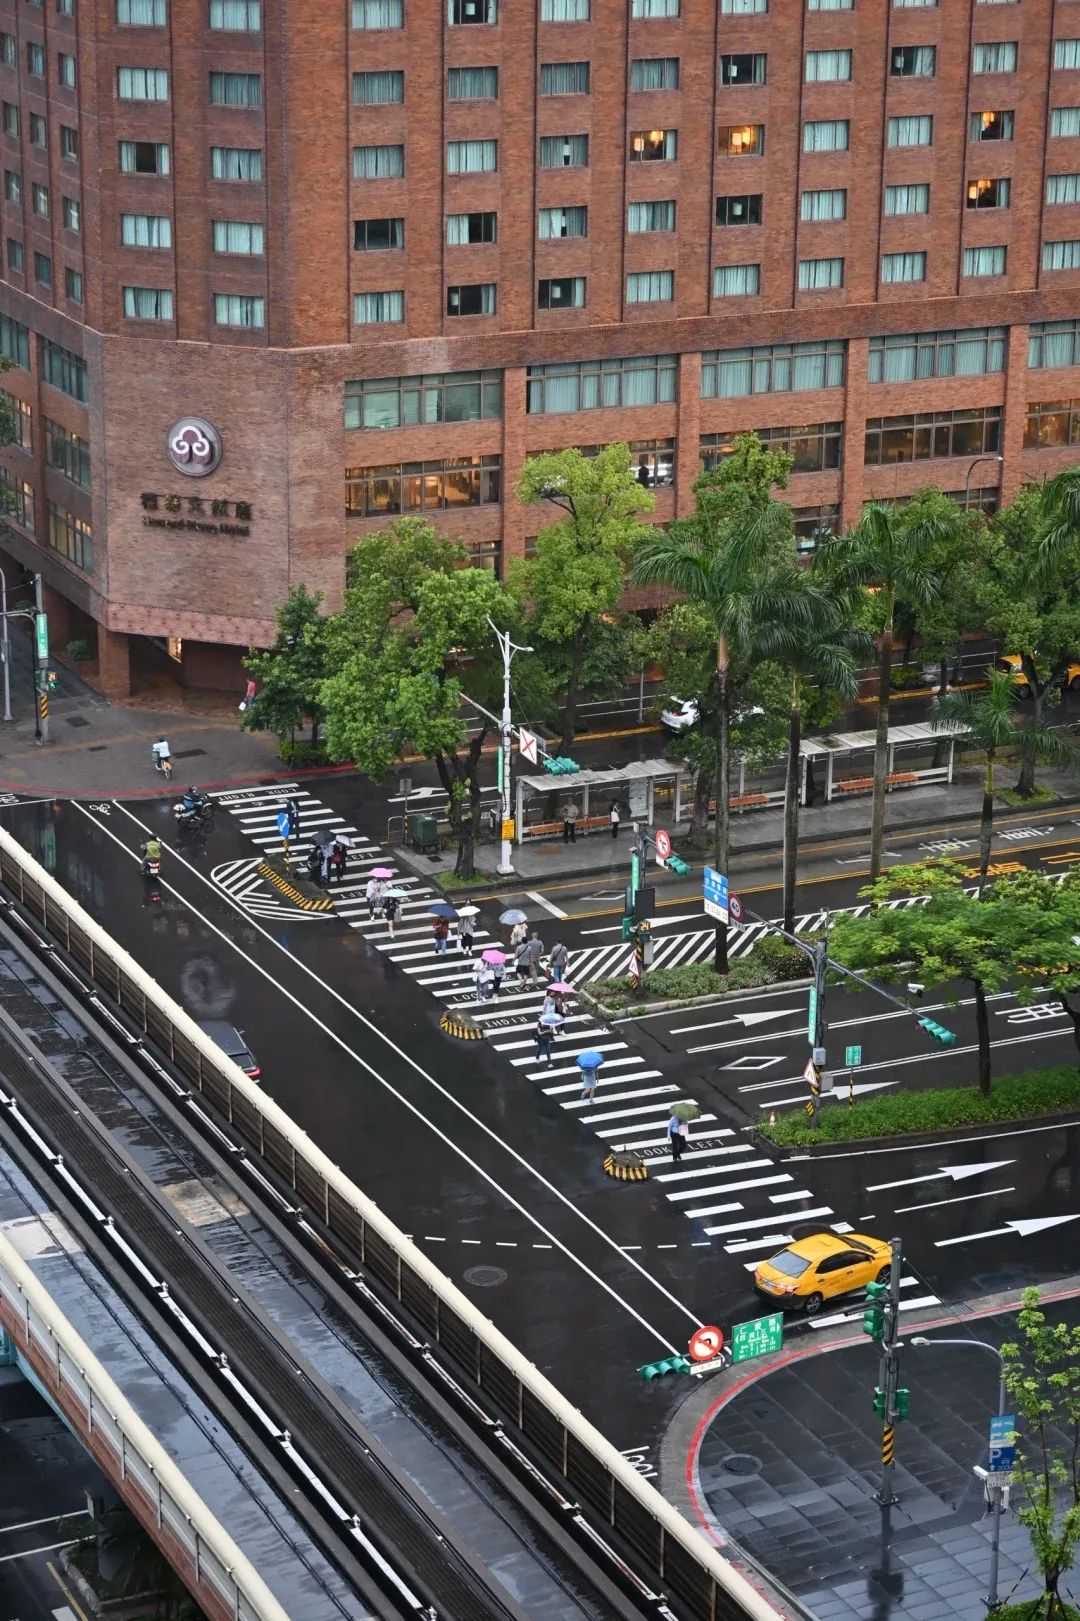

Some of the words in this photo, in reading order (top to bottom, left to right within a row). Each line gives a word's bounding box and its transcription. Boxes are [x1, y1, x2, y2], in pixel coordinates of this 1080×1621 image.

[217, 791, 256, 802] RIGHT
[451, 992, 479, 1003] LOO
[484, 1015, 529, 1029] RIGHT
[632, 1145, 673, 1159] LOOK
[687, 1138, 727, 1152] LEFT
